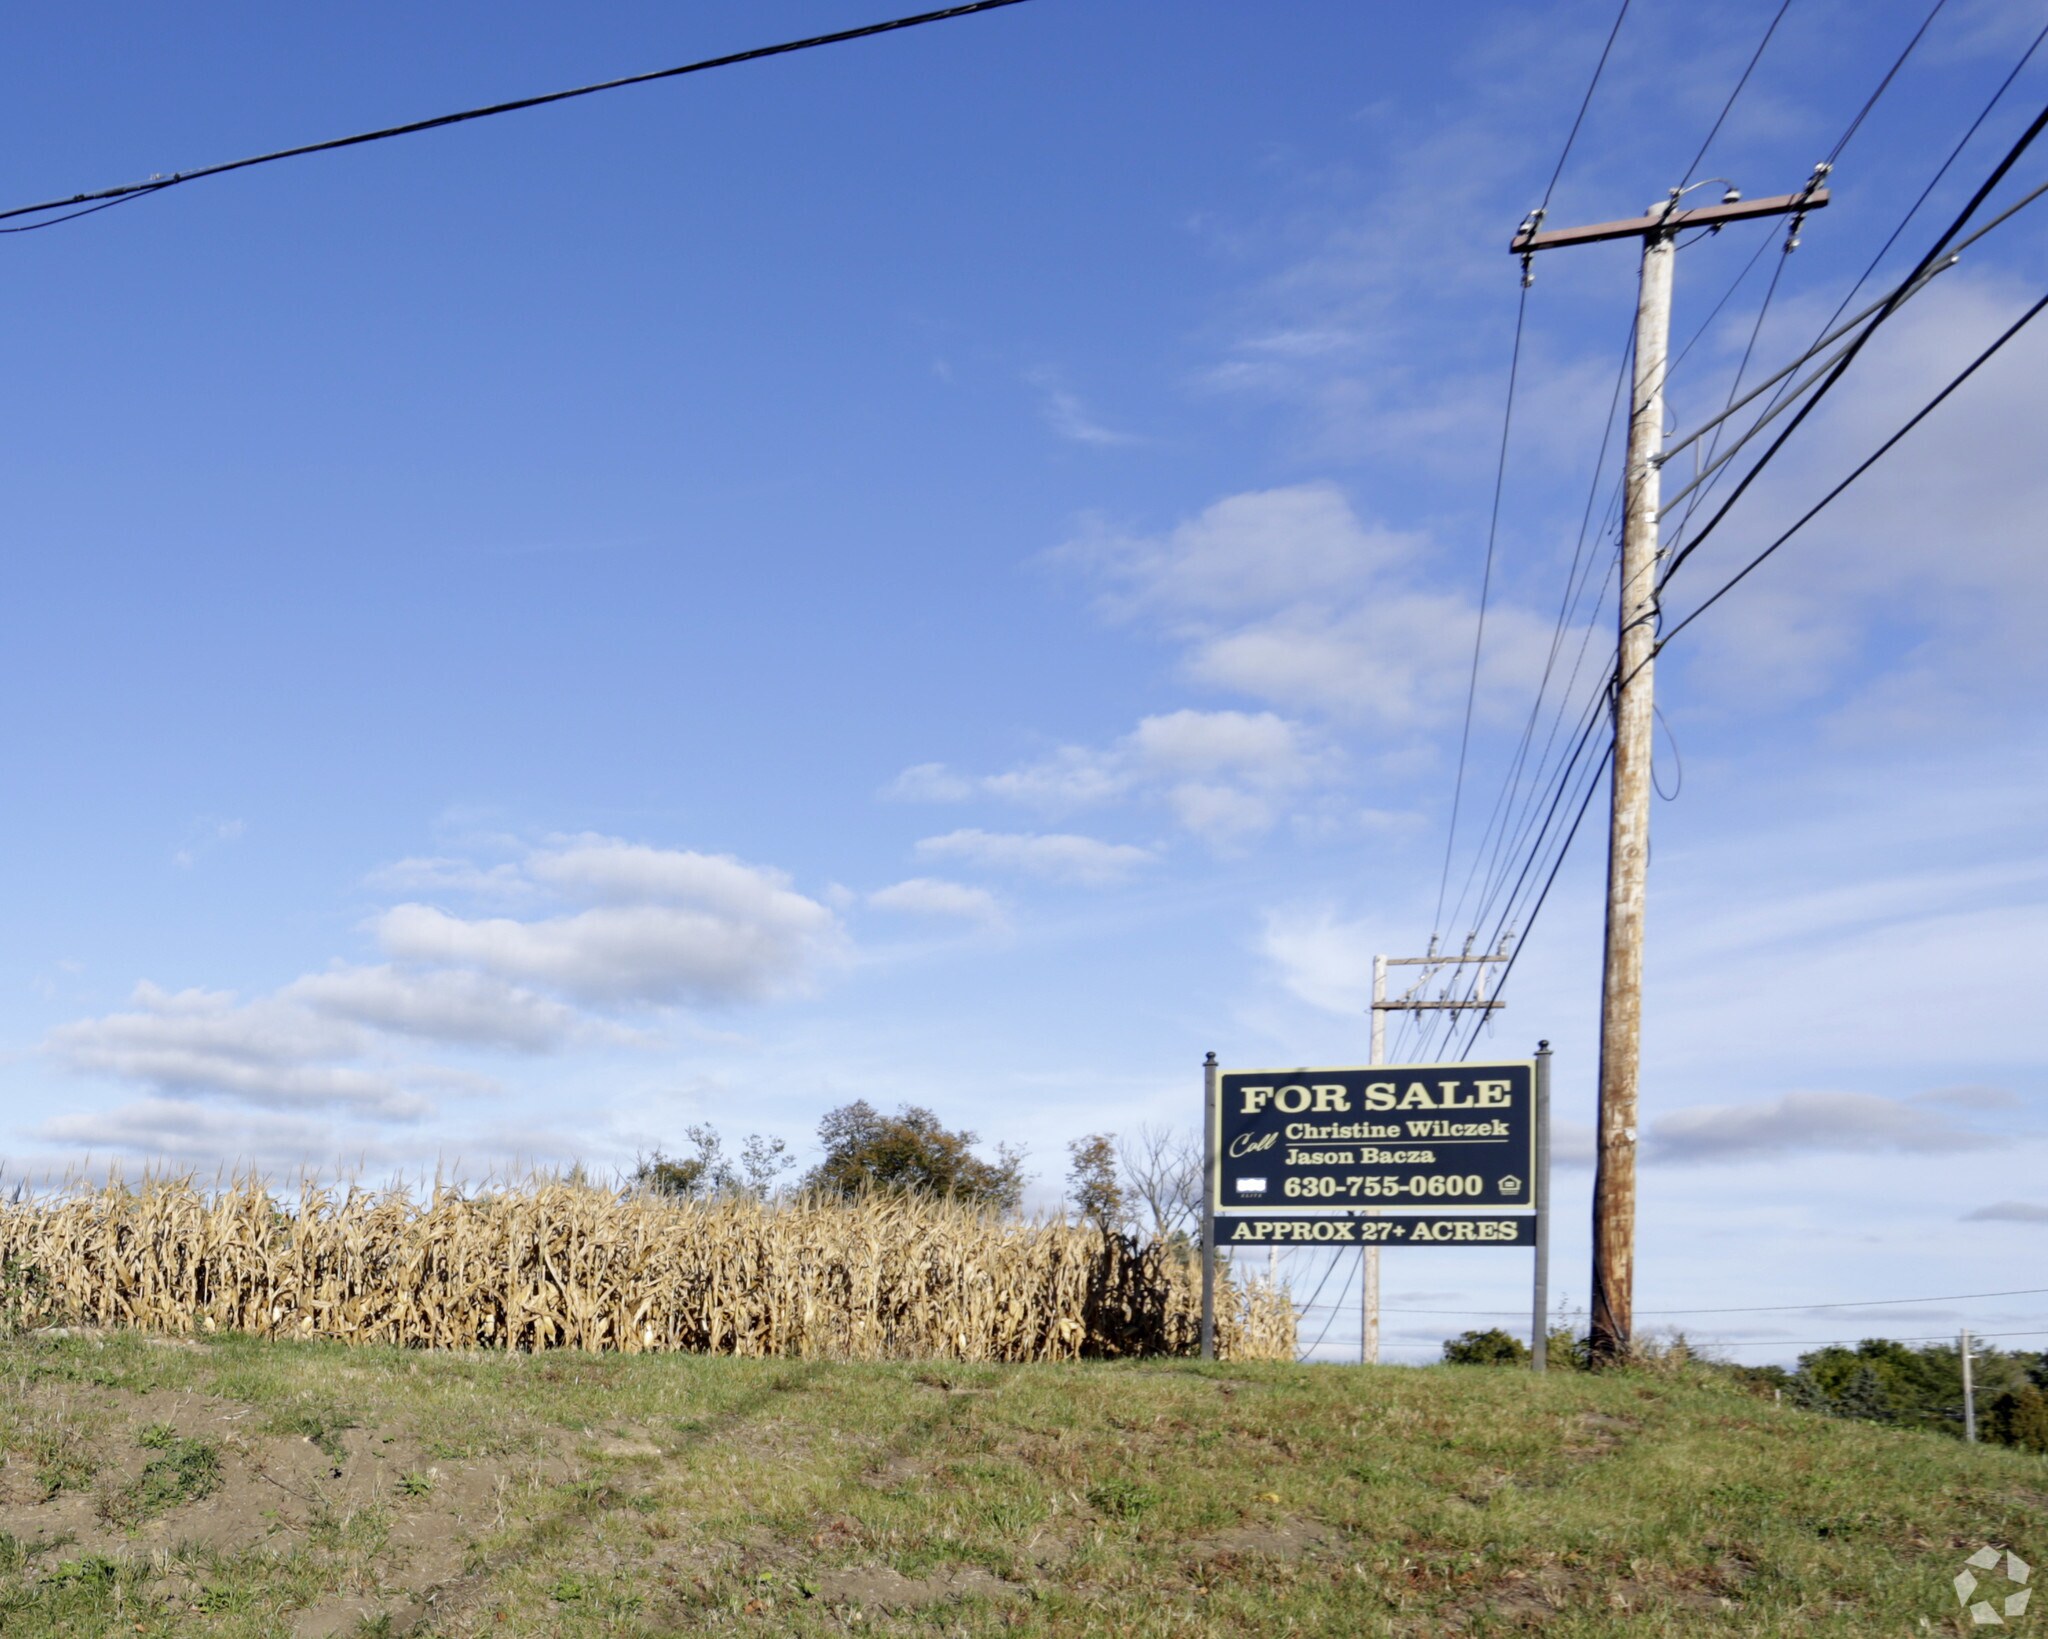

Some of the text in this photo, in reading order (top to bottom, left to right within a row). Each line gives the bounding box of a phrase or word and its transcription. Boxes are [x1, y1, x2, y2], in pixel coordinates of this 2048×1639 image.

[1240, 1079, 1513, 1114] FOR SALE
[1284, 1118, 1510, 1141] Christine Wilczek
[1229, 1131, 1280, 1158] Call
[1284, 1147, 1436, 1166] Jason Bacza
[1283, 1174, 1483, 1198] 630-755-0600
[1230, 1220, 1519, 1241] APPROX 27+ ACRES
